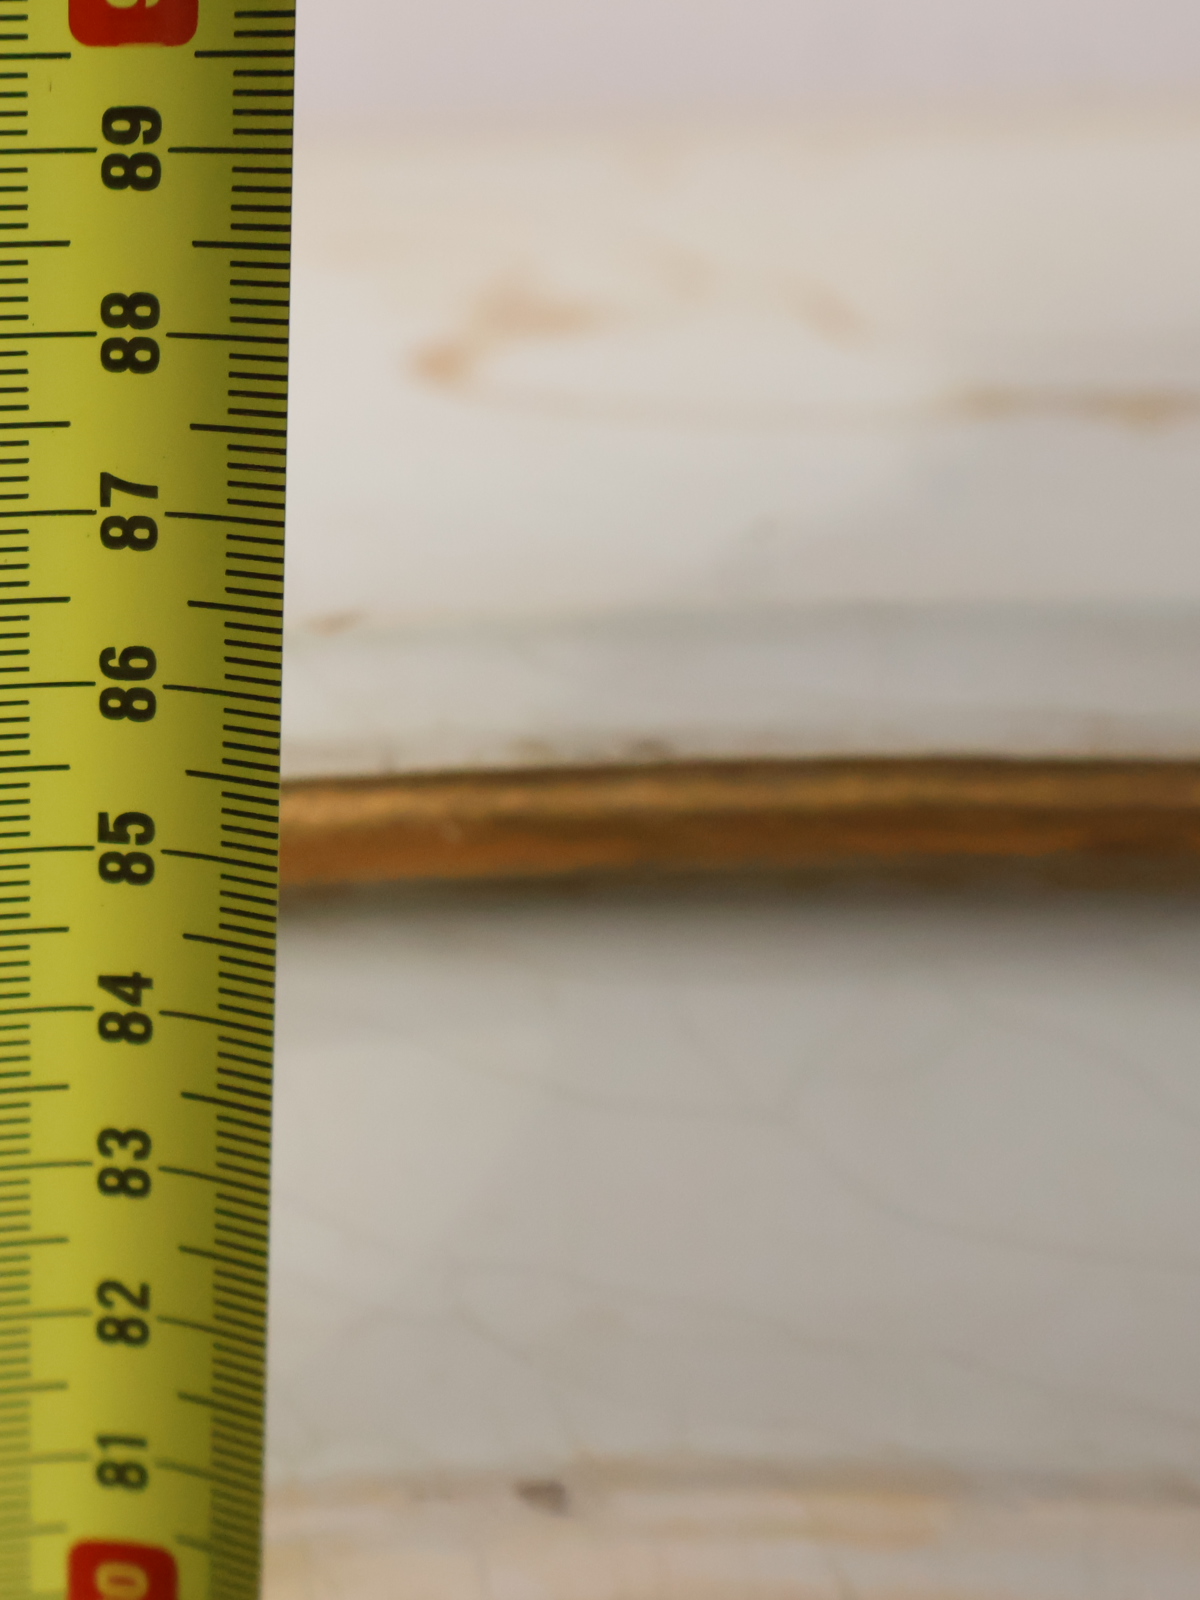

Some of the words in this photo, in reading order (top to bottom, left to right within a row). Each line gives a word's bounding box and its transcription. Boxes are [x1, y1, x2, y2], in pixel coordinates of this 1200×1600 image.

[101, 105, 162, 192] 89
[100, 291, 161, 375] 88
[100, 471, 159, 552] 87
[99, 645, 157, 723] 86
[98, 811, 156, 886] 85
[97, 970, 154, 1046] 84
[97, 1127, 152, 1200] 83
[96, 1279, 150, 1347] 82
[96, 1434, 148, 1492] 81
[95, 1562, 149, 1600] 0
